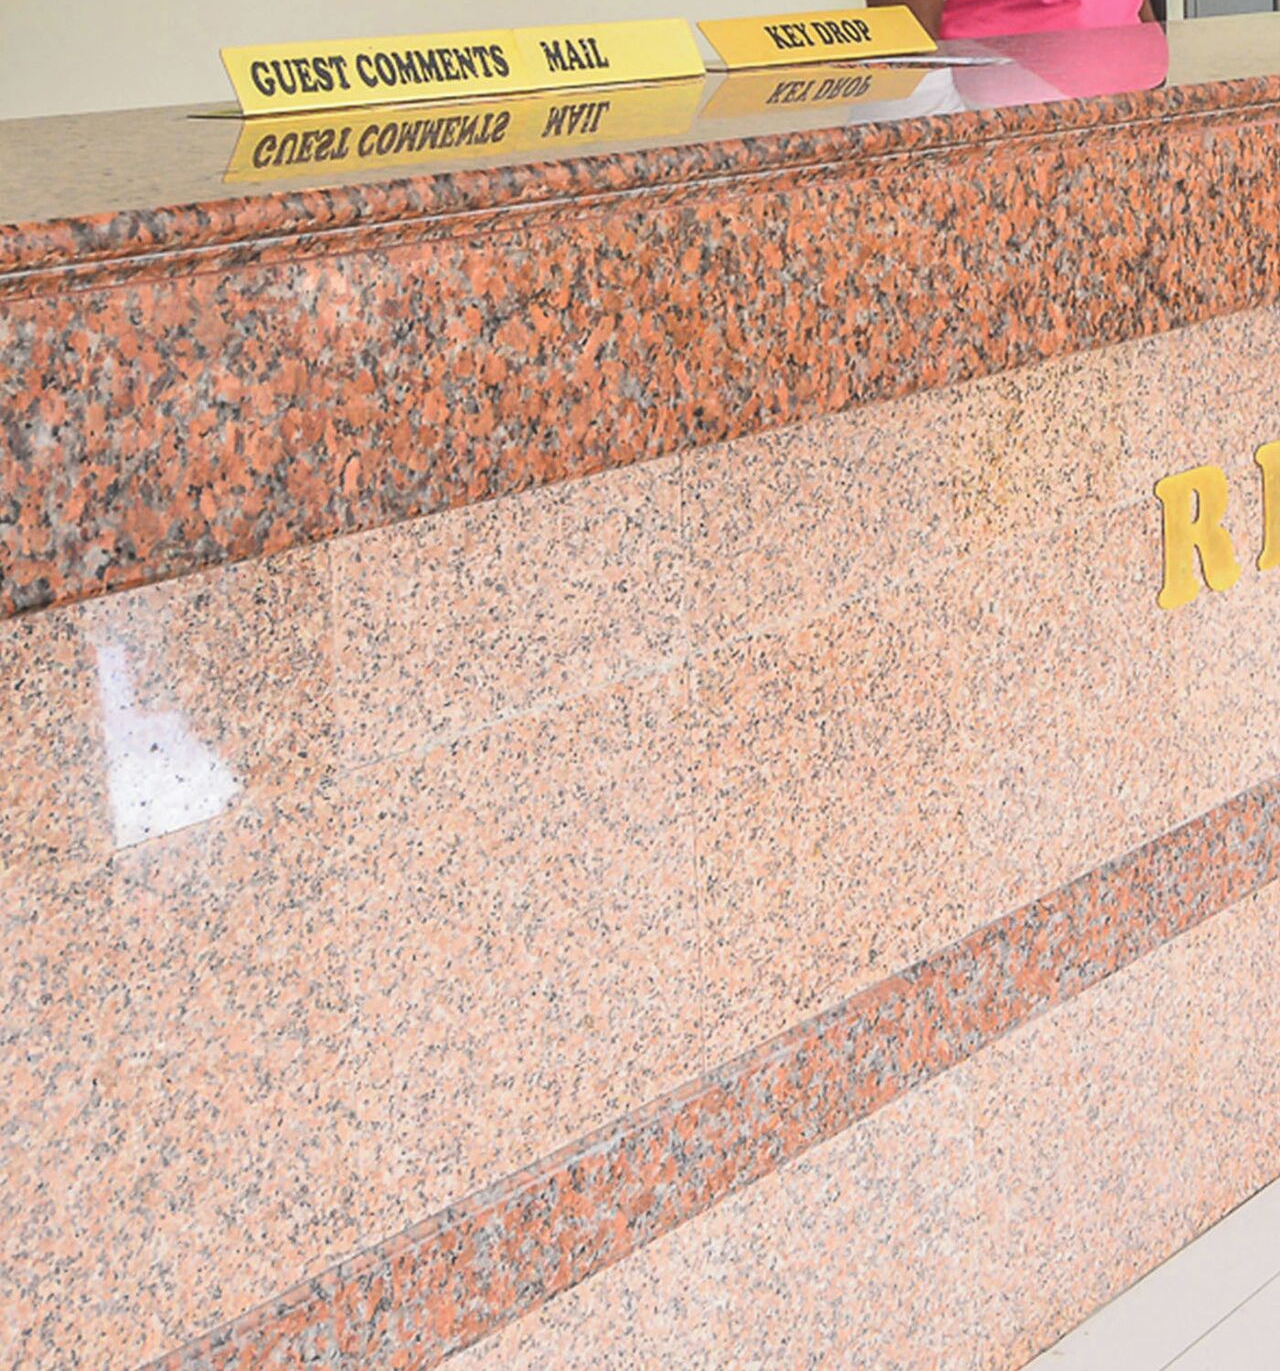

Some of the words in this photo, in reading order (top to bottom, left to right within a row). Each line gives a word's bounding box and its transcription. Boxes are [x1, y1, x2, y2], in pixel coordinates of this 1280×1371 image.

[763, 22, 816, 50] KEY
[818, 18, 873, 45] DROP
[250, 54, 351, 97] GUEST
[355, 44, 510, 88] COMMENTS
[539, 37, 610, 72] MAIL
